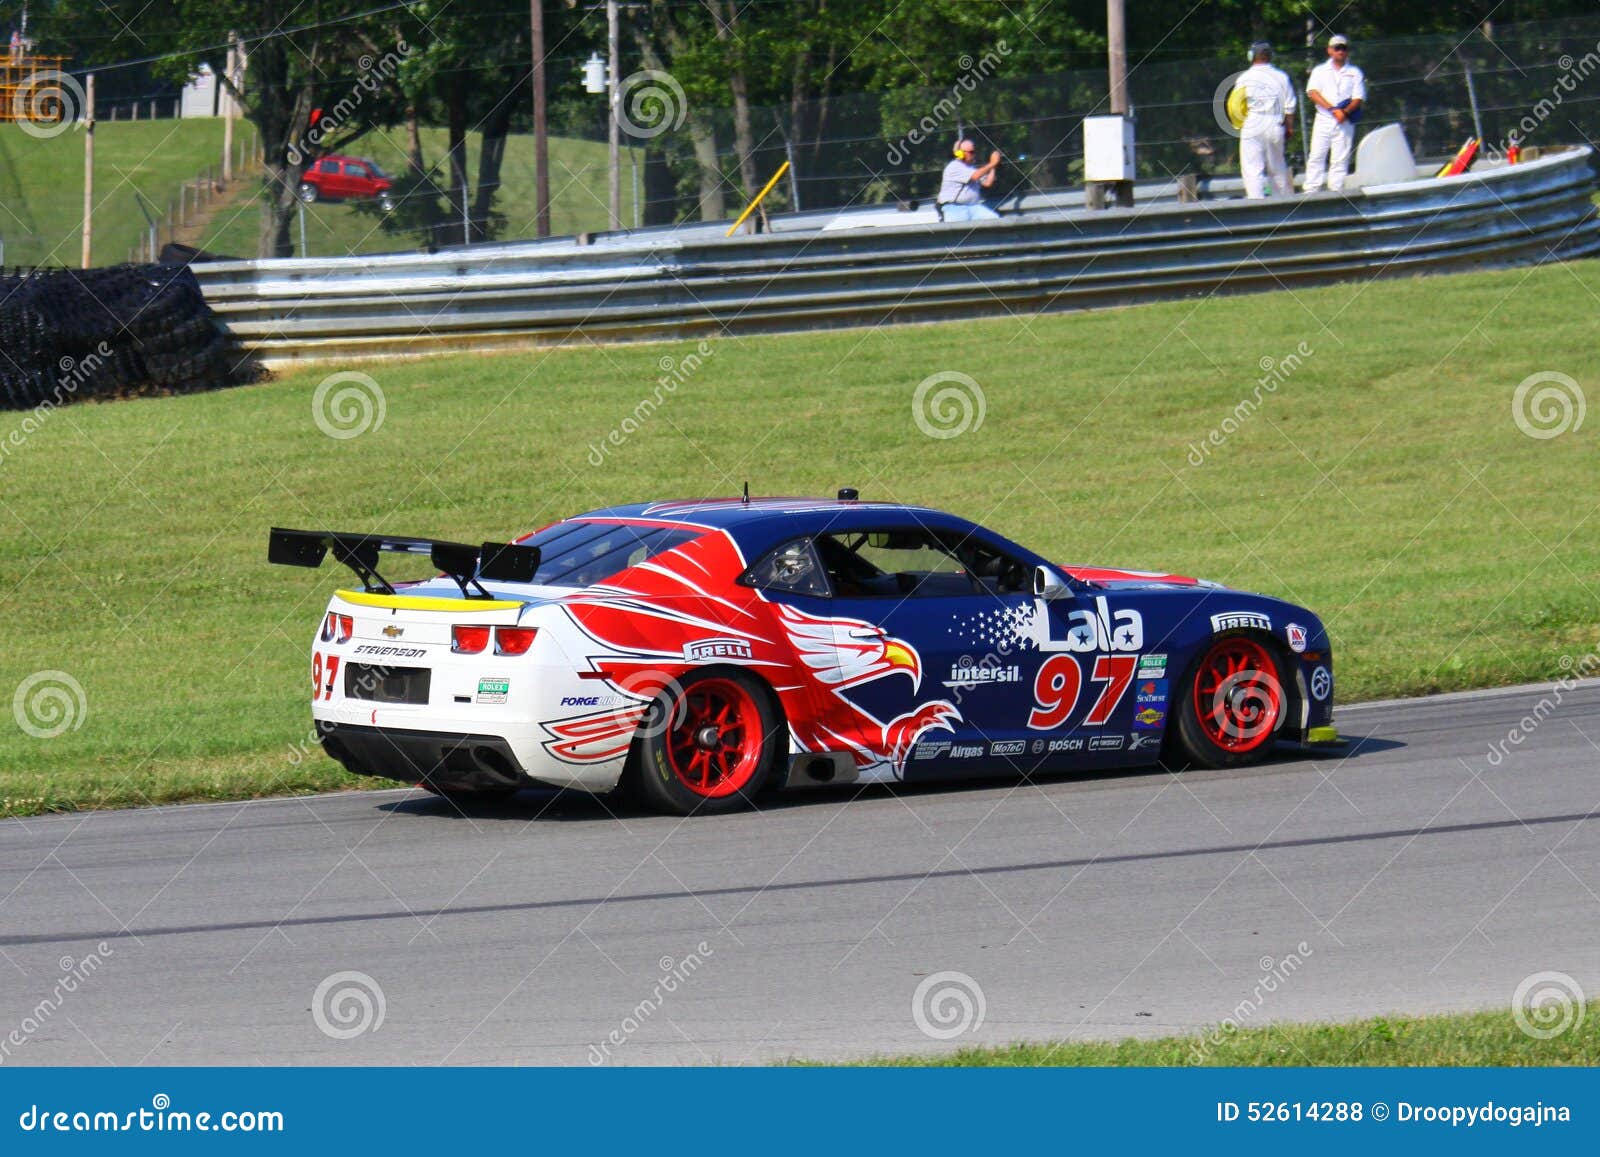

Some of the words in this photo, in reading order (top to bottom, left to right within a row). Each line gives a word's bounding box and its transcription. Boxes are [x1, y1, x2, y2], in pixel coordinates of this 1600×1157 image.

[1034, 596, 1143, 652] Lala
[1210, 611, 1272, 633] PIRELLI
[354, 645, 427, 658] STEVENSON
[682, 637, 752, 663] PIRELLI
[1143, 659, 1163, 667] ROLEX
[313, 651, 340, 701] 97
[951, 663, 1019, 682] intersil
[482, 683, 504, 691] ROLEX
[1027, 653, 1139, 730] 97
[949, 745, 983, 758] Airgas
[992, 743, 1023, 753] MoTeC
[1048, 739, 1083, 751] BOSCH
